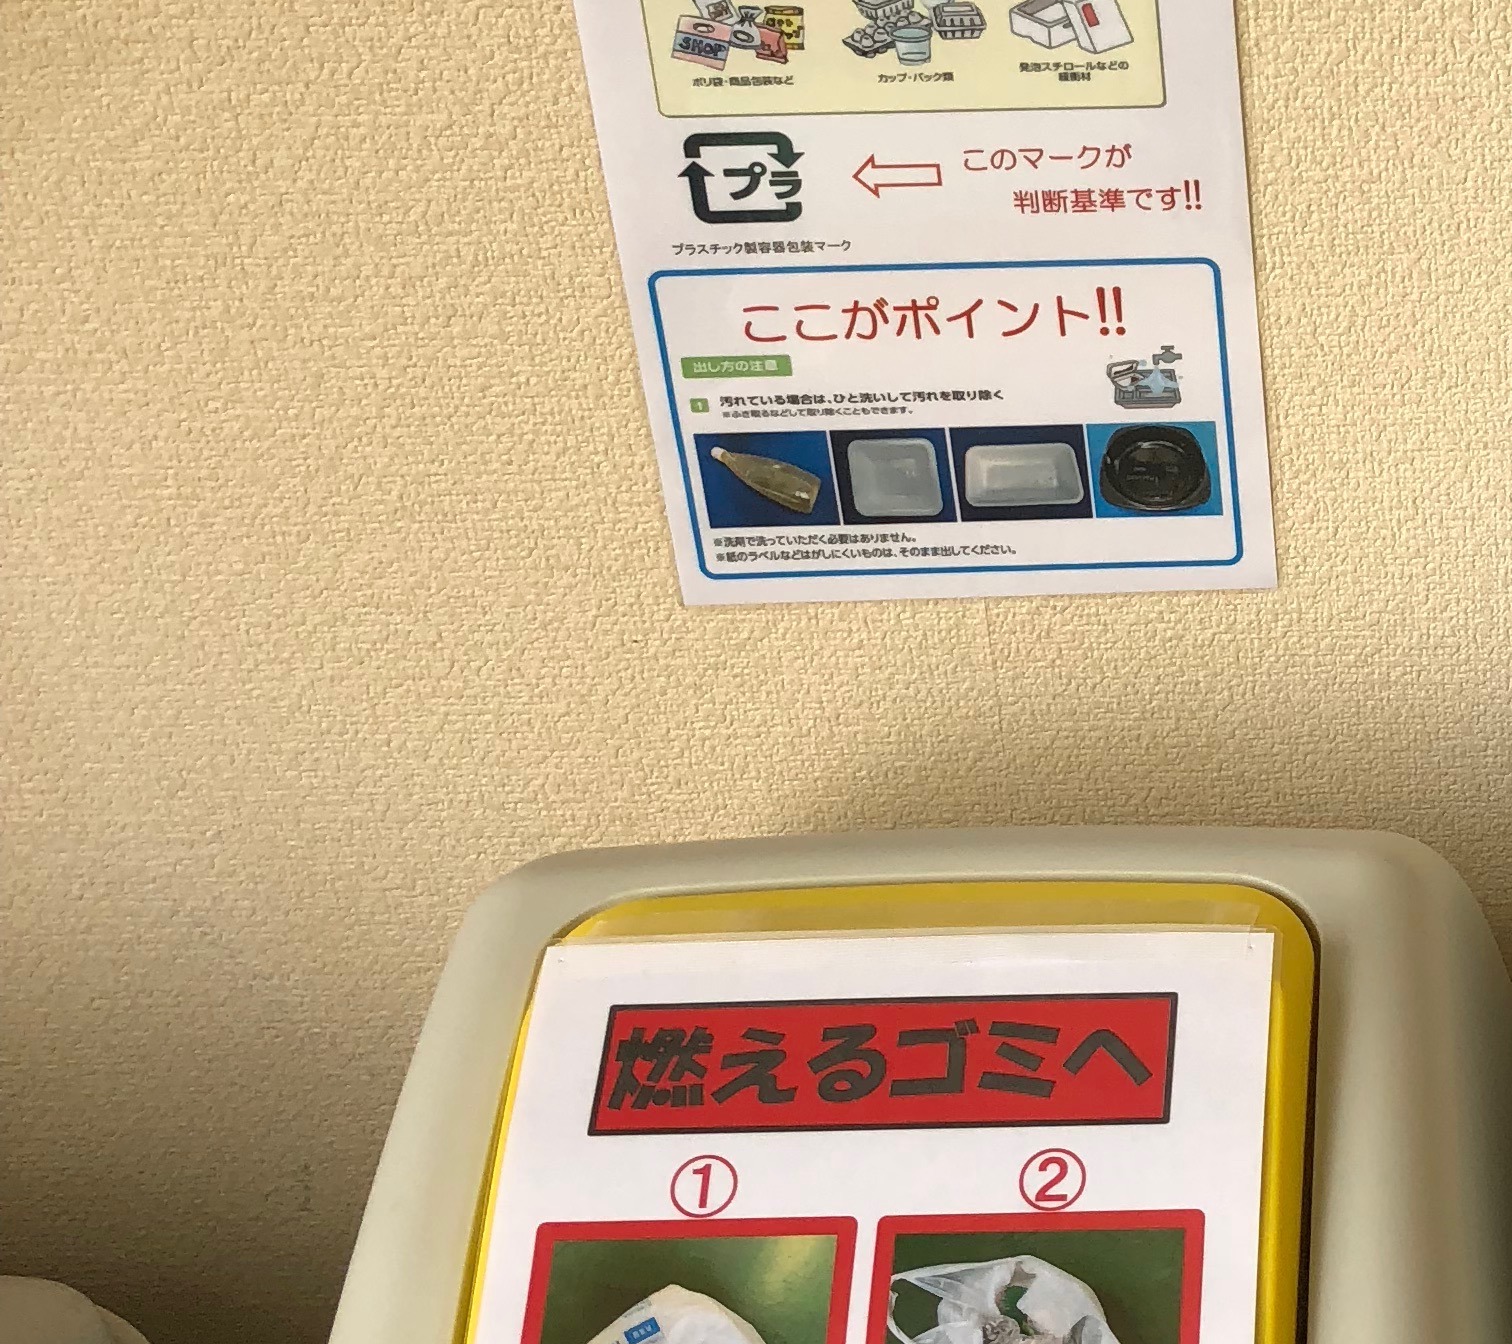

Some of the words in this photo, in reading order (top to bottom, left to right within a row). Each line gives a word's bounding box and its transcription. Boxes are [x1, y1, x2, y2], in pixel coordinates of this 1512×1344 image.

[679, 36, 727, 56] SHOP
[963, 142, 1132, 172] このマークが
[723, 164, 802, 200] プラ
[1012, 180, 1203, 215] 判断基準です!!
[671, 238, 852, 256] プラスチック製容器包装マーク
[742, 285, 1127, 343] ここがポイント!!
[719, 389, 1004, 407] 汚れている場合は、ひと洗いして汚れを取り除く
[608, 1018, 1153, 1111] 燃えるゴミへ
